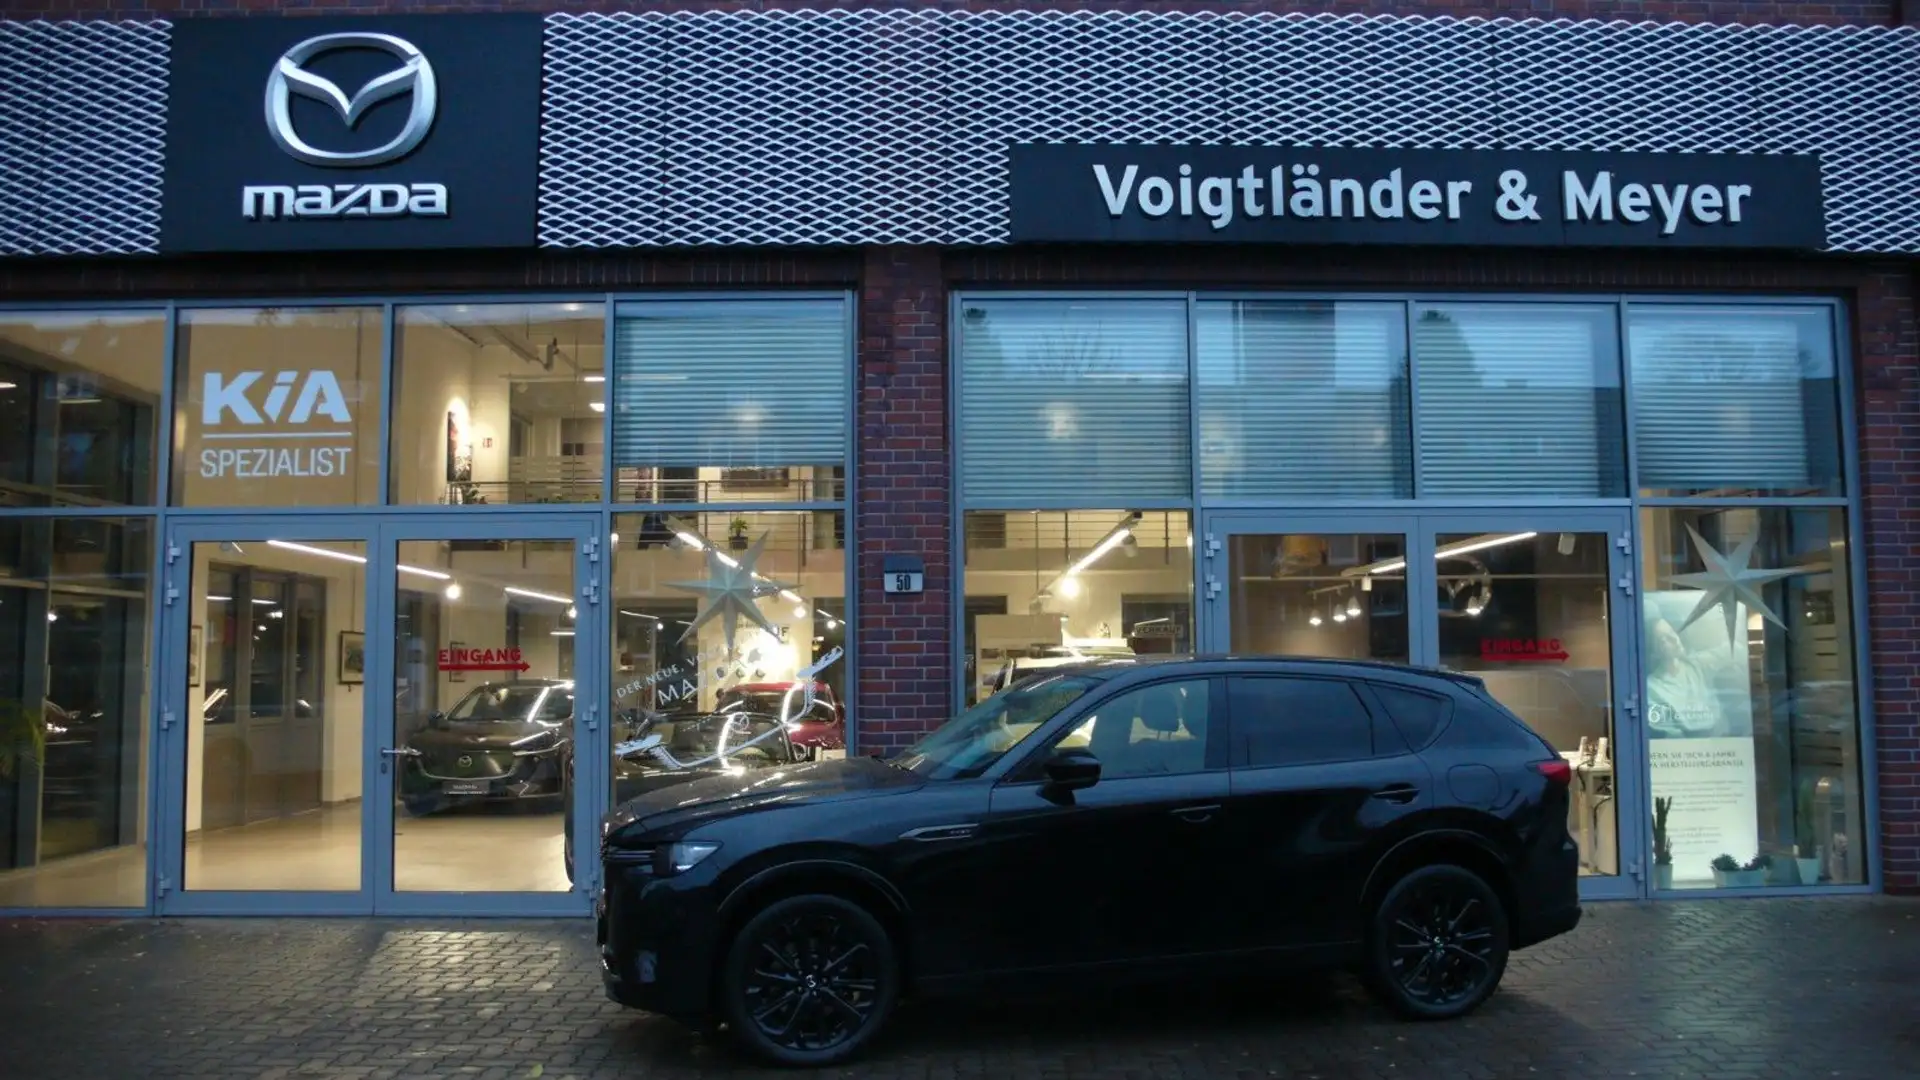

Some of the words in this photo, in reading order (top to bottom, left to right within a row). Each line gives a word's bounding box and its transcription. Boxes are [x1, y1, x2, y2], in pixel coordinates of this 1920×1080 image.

[1092, 164, 1472, 229] Voigtländer
[1496, 170, 1541, 220] &
[1564, 171, 1752, 234] Meyer
[201, 448, 352, 477] SPEZIALIST
[896, 574, 911, 591] 50
[1482, 638, 1560, 653] EINGANG
[439, 648, 521, 662] EINGANG
[616, 680, 642, 698] DER
